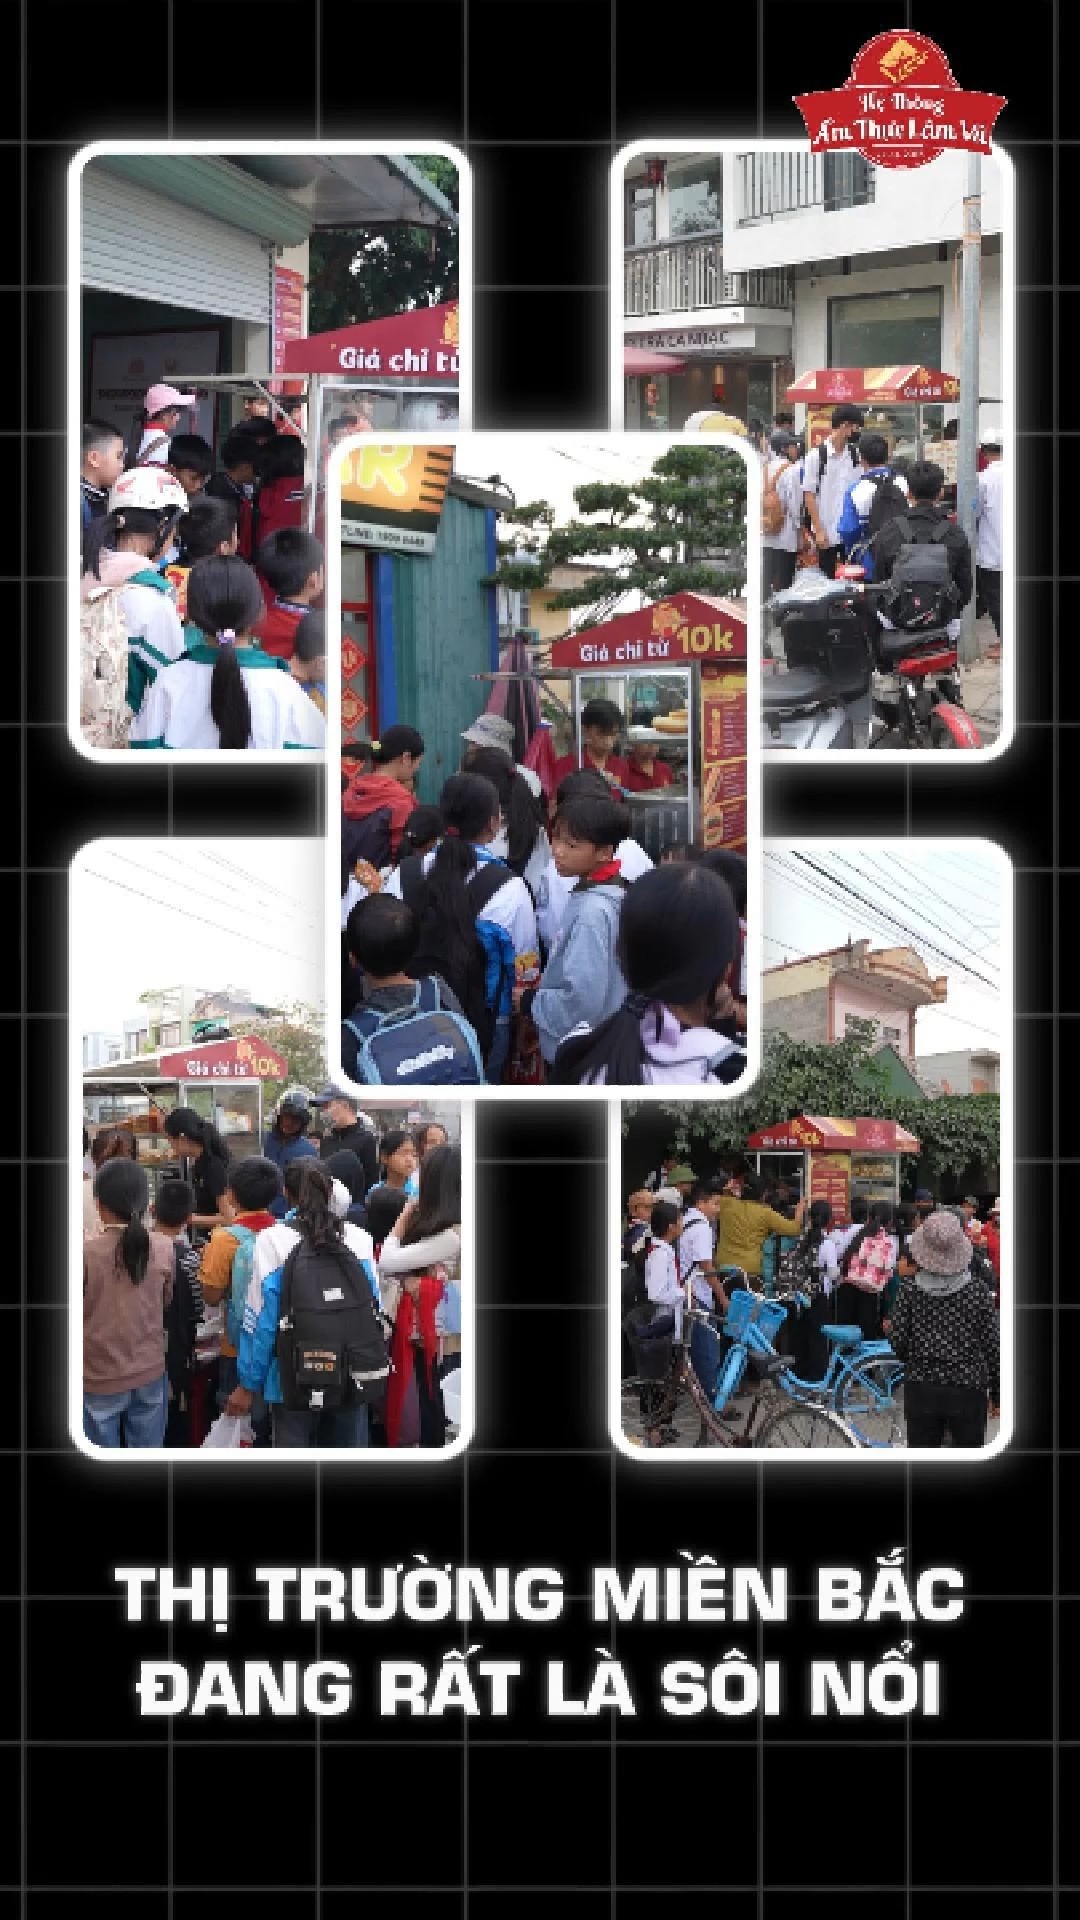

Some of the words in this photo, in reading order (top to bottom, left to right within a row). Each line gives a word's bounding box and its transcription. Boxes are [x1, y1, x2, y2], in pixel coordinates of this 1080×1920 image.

[338, 346, 381, 371] Giá
[579, 643, 609, 662] Giá
[647, 636, 670, 657] từ
[676, 624, 734, 654] 10k
